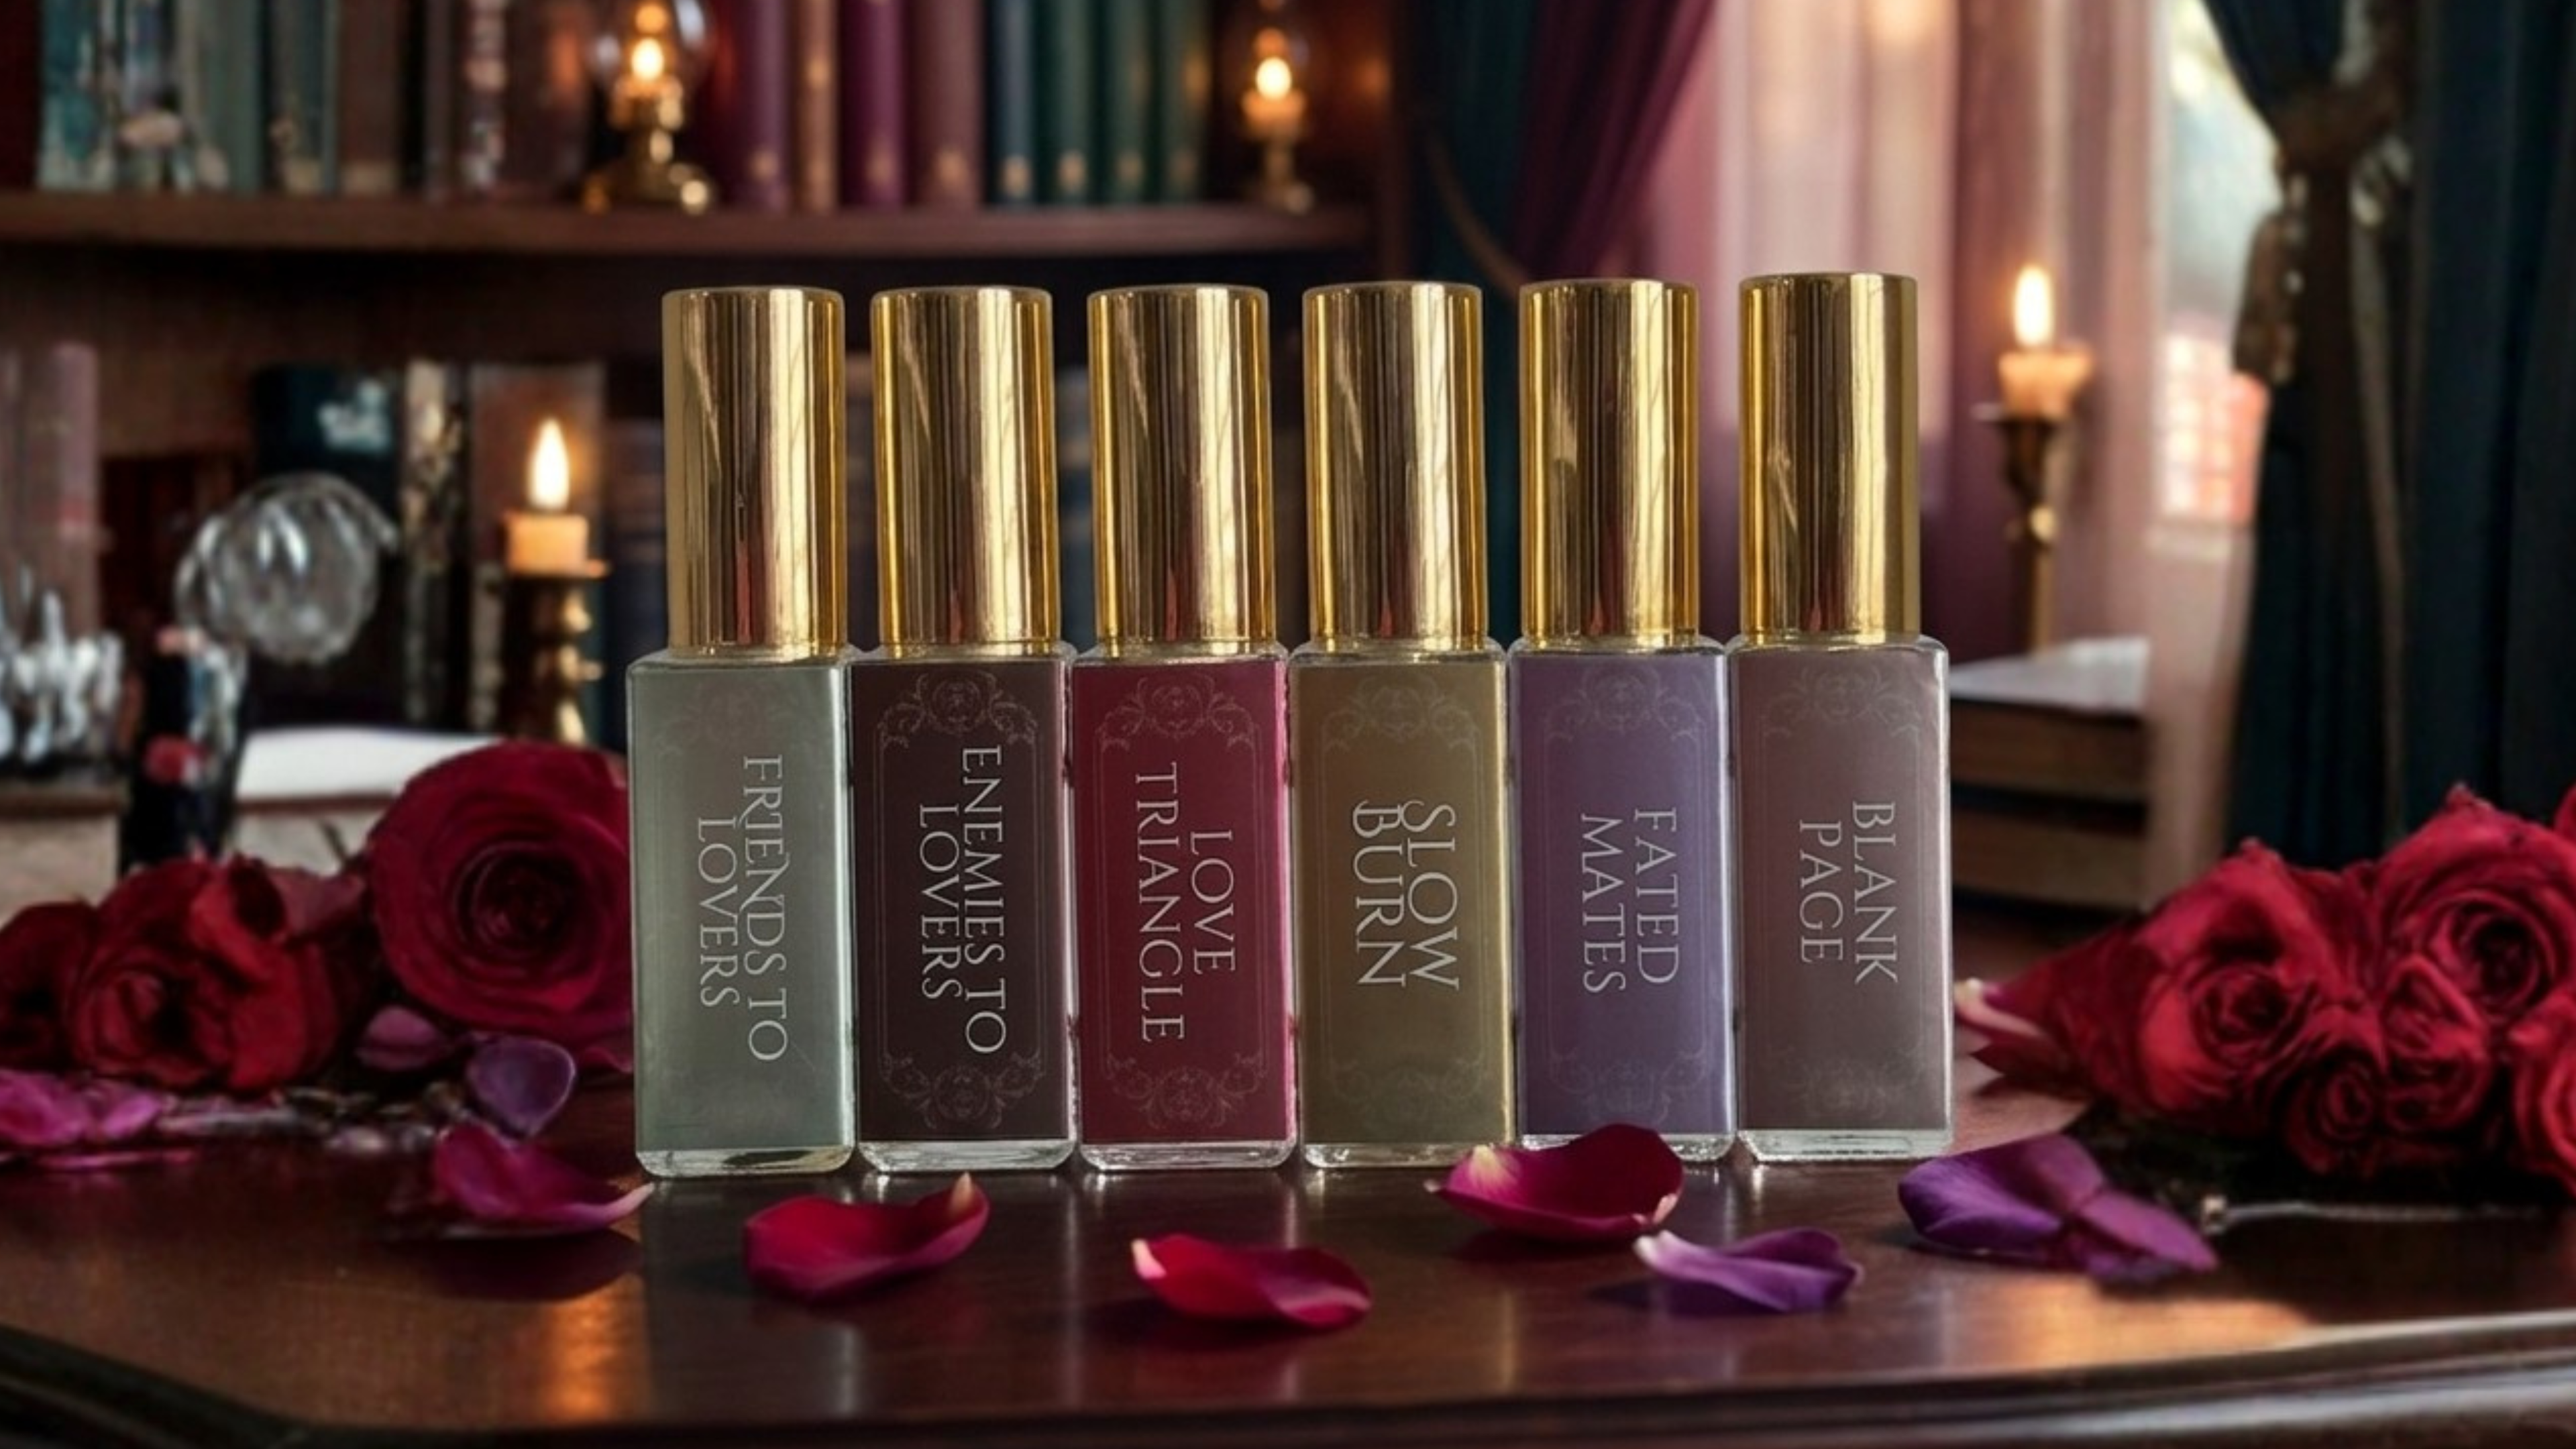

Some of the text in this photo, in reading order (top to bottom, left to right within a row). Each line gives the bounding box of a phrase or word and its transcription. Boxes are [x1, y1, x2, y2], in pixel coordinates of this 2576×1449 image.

[698, 816, 739, 1006] LOVERS
[739, 755, 790, 1060] FRIENDS TO
[919, 804, 961, 1000] LOVERS
[962, 745, 1006, 1053] ENEMIES TO
[1136, 761, 1185, 1042] TRIANGLE
[1190, 830, 1236, 975] LOVE
[1352, 799, 1406, 987] BURN
[1401, 800, 1459, 991] SLOW
[1580, 813, 1626, 993] MATES
[1634, 808, 1678, 983] FATED
[1799, 820, 1843, 963] PAGE
[1853, 801, 1898, 984] BLANK
